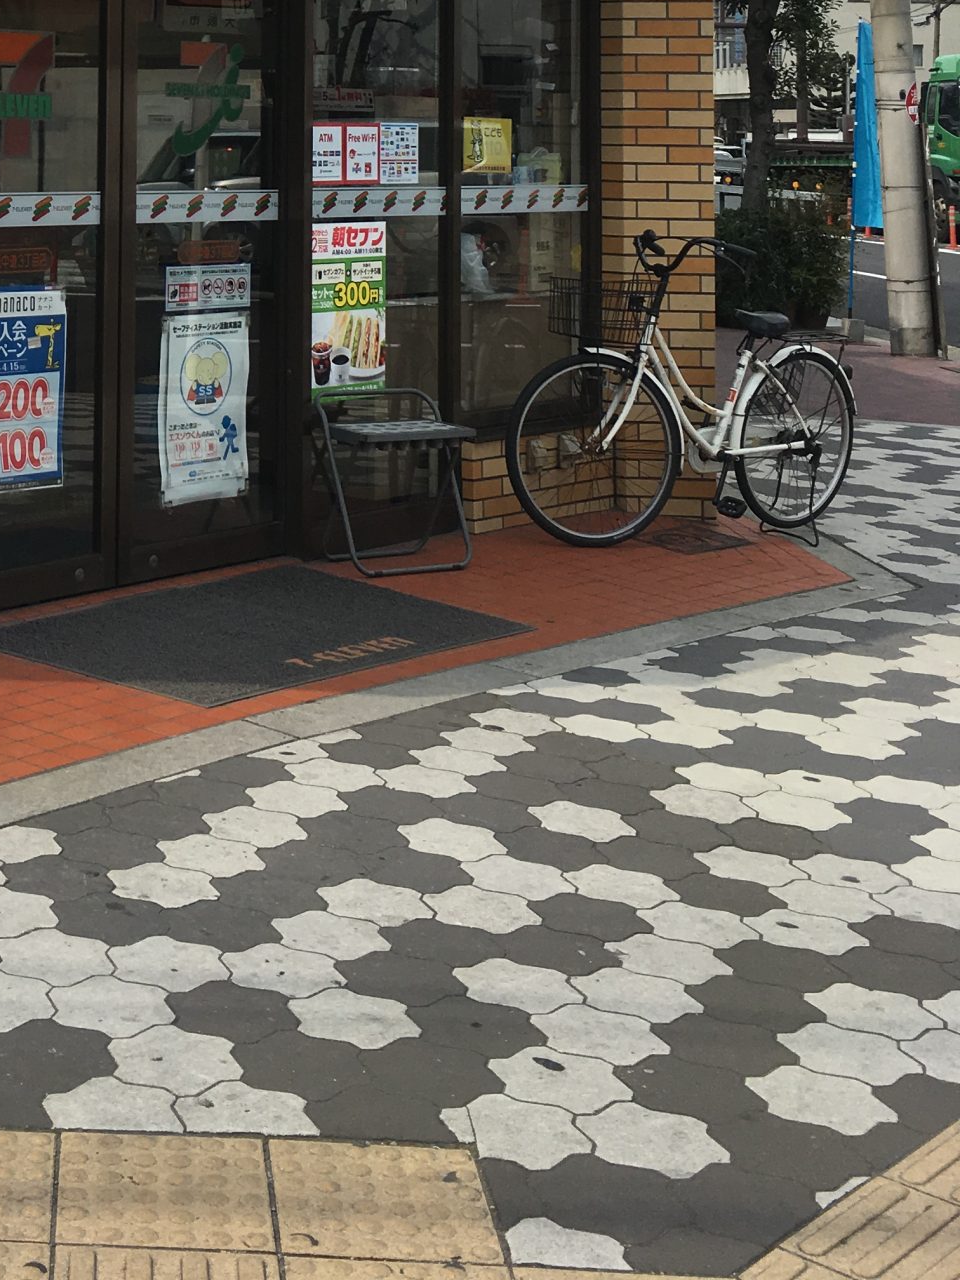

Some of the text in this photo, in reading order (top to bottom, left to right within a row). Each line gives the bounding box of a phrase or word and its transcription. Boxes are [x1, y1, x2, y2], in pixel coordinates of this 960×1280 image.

[318, 133, 334, 143] ATM
[348, 133, 377, 143] Free Wi-Fi
[484, 127, 503, 138] こども
[331, 226, 384, 248] 朝セブン
[333, 280, 380, 308] 300円
[198, 385, 213, 396] SS
